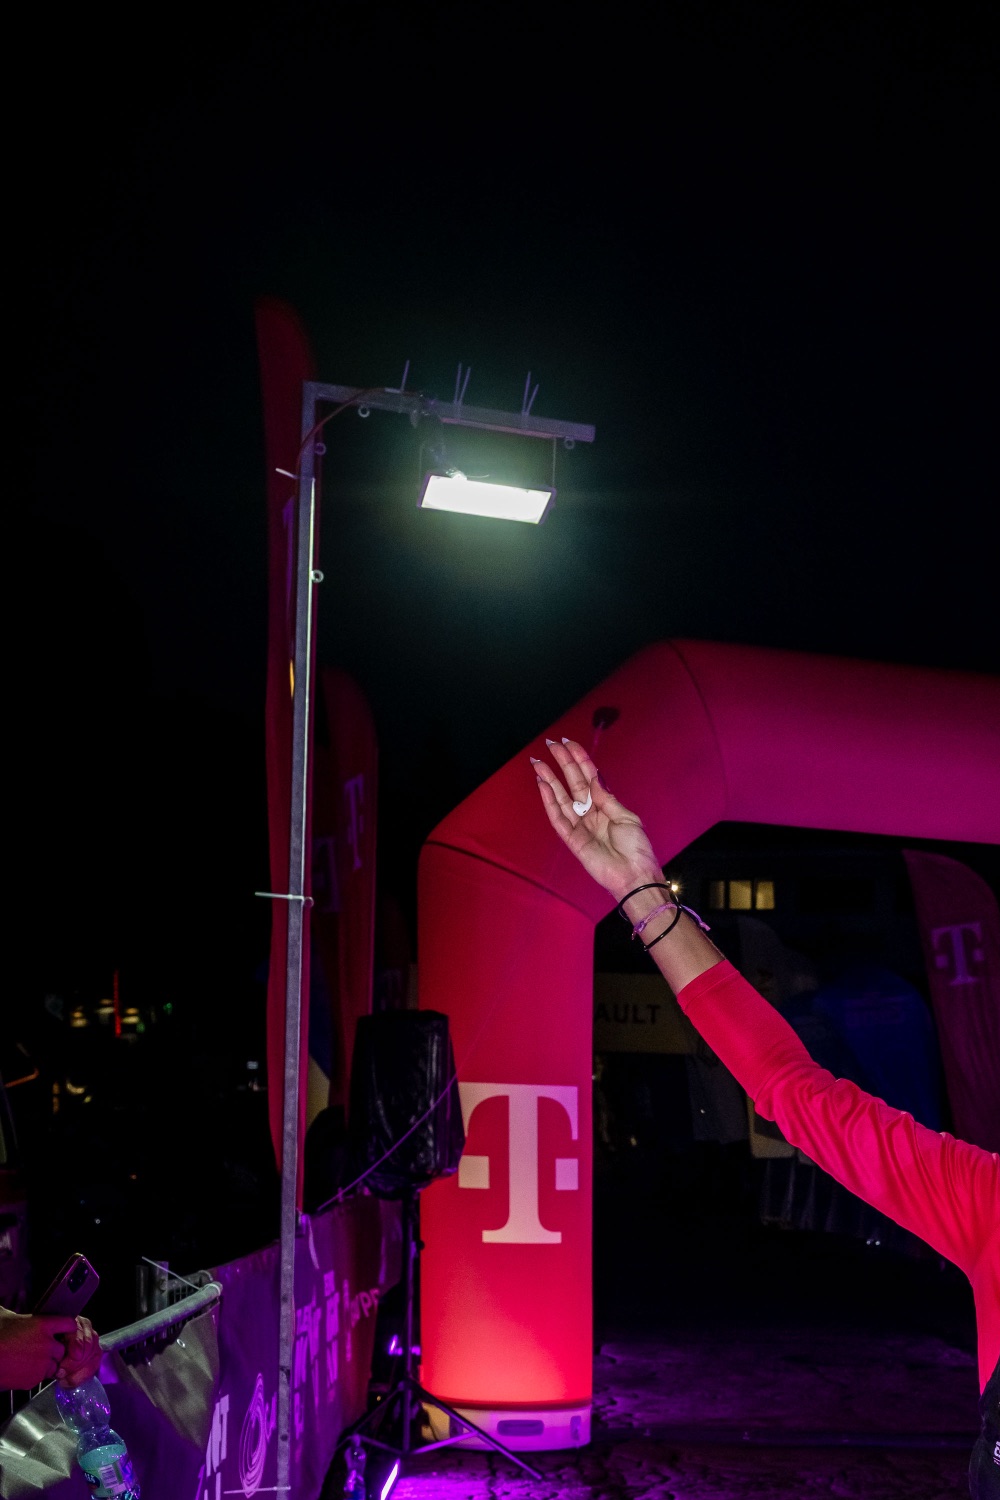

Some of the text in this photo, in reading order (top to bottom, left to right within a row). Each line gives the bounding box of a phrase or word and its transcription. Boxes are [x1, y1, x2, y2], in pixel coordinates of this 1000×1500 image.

[931, 922, 983, 986] T
[594, 1003, 662, 1025] AULT
[458, 1082, 578, 1244] T
